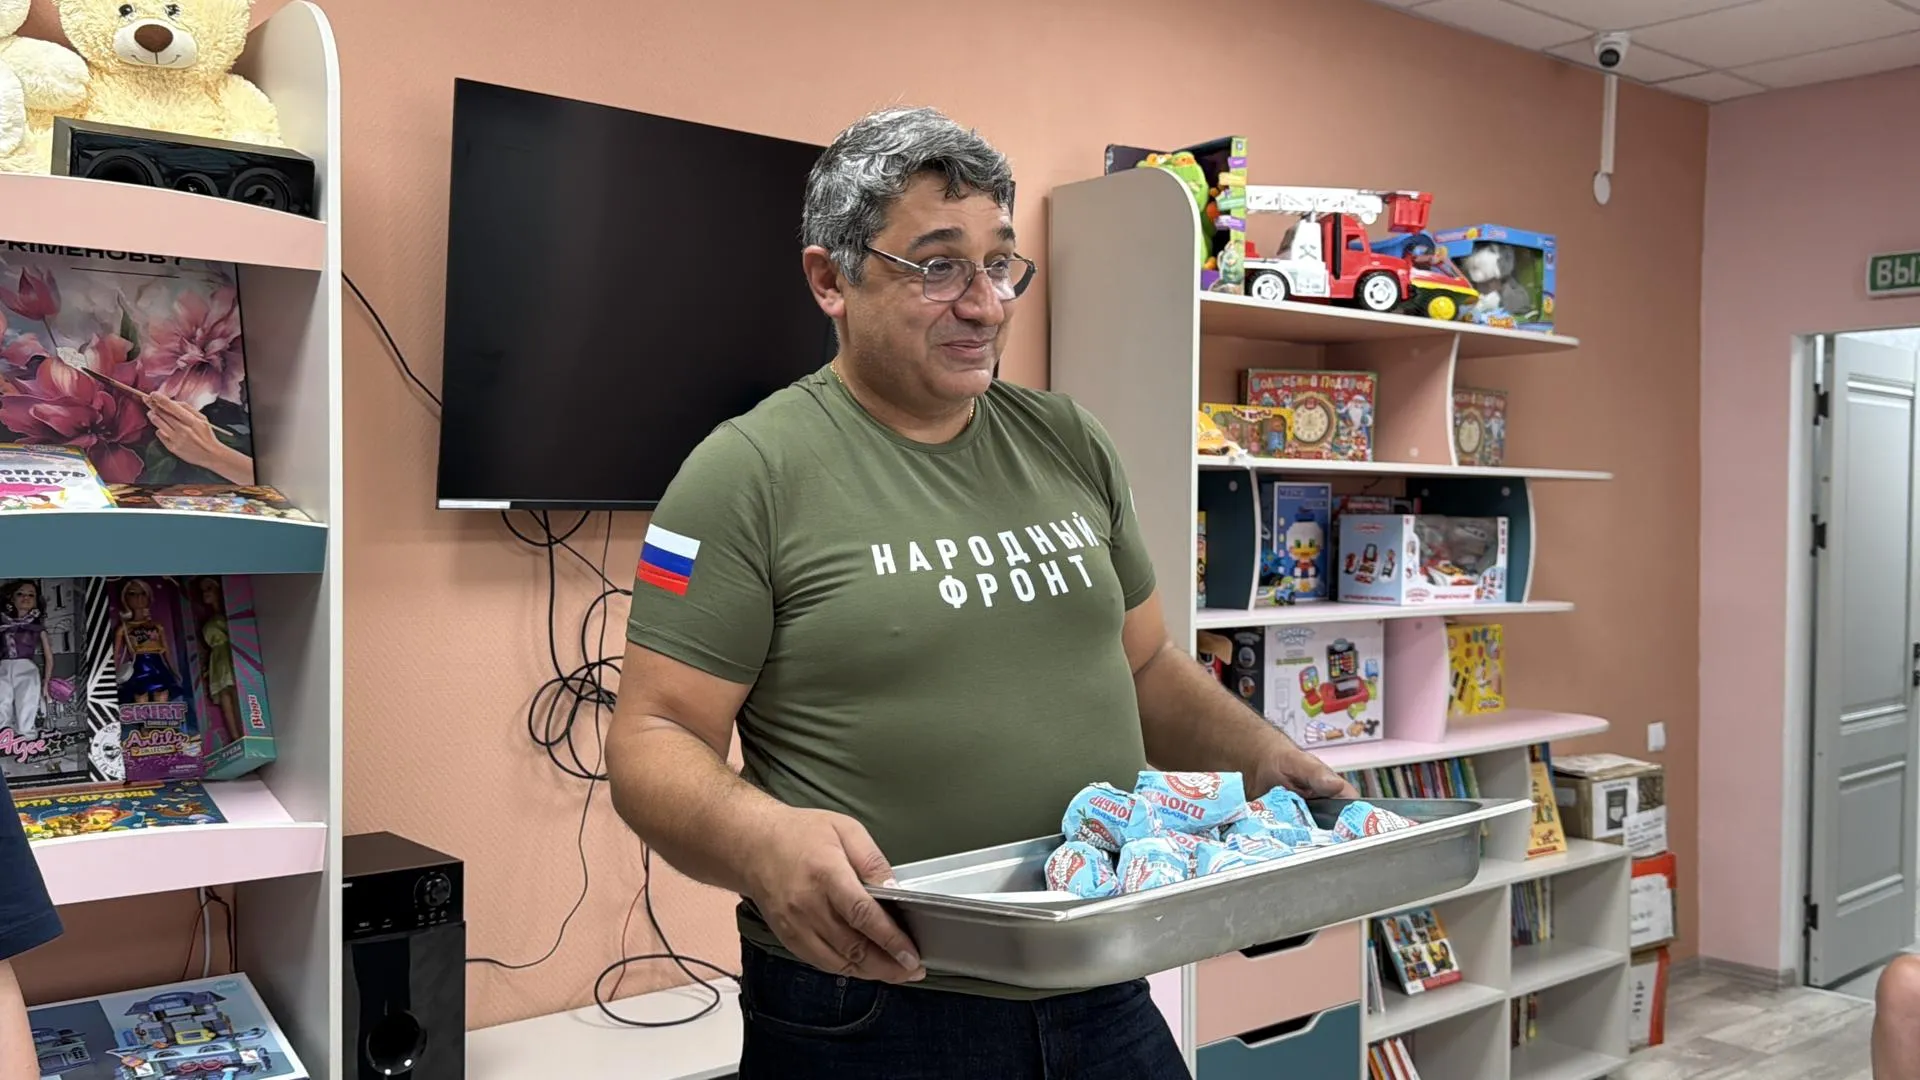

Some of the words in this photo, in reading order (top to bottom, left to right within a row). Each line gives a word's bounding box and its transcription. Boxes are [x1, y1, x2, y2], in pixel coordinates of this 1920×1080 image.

[1876, 256, 1920, 287] ВЫ
[871, 512, 1099, 575] НАРОДНЫЙ
[938, 554, 1093, 608] ФРОНТ
[119, 703, 185, 722] SKIRT
[56, 790, 156, 804] СОКРОВИЩ
